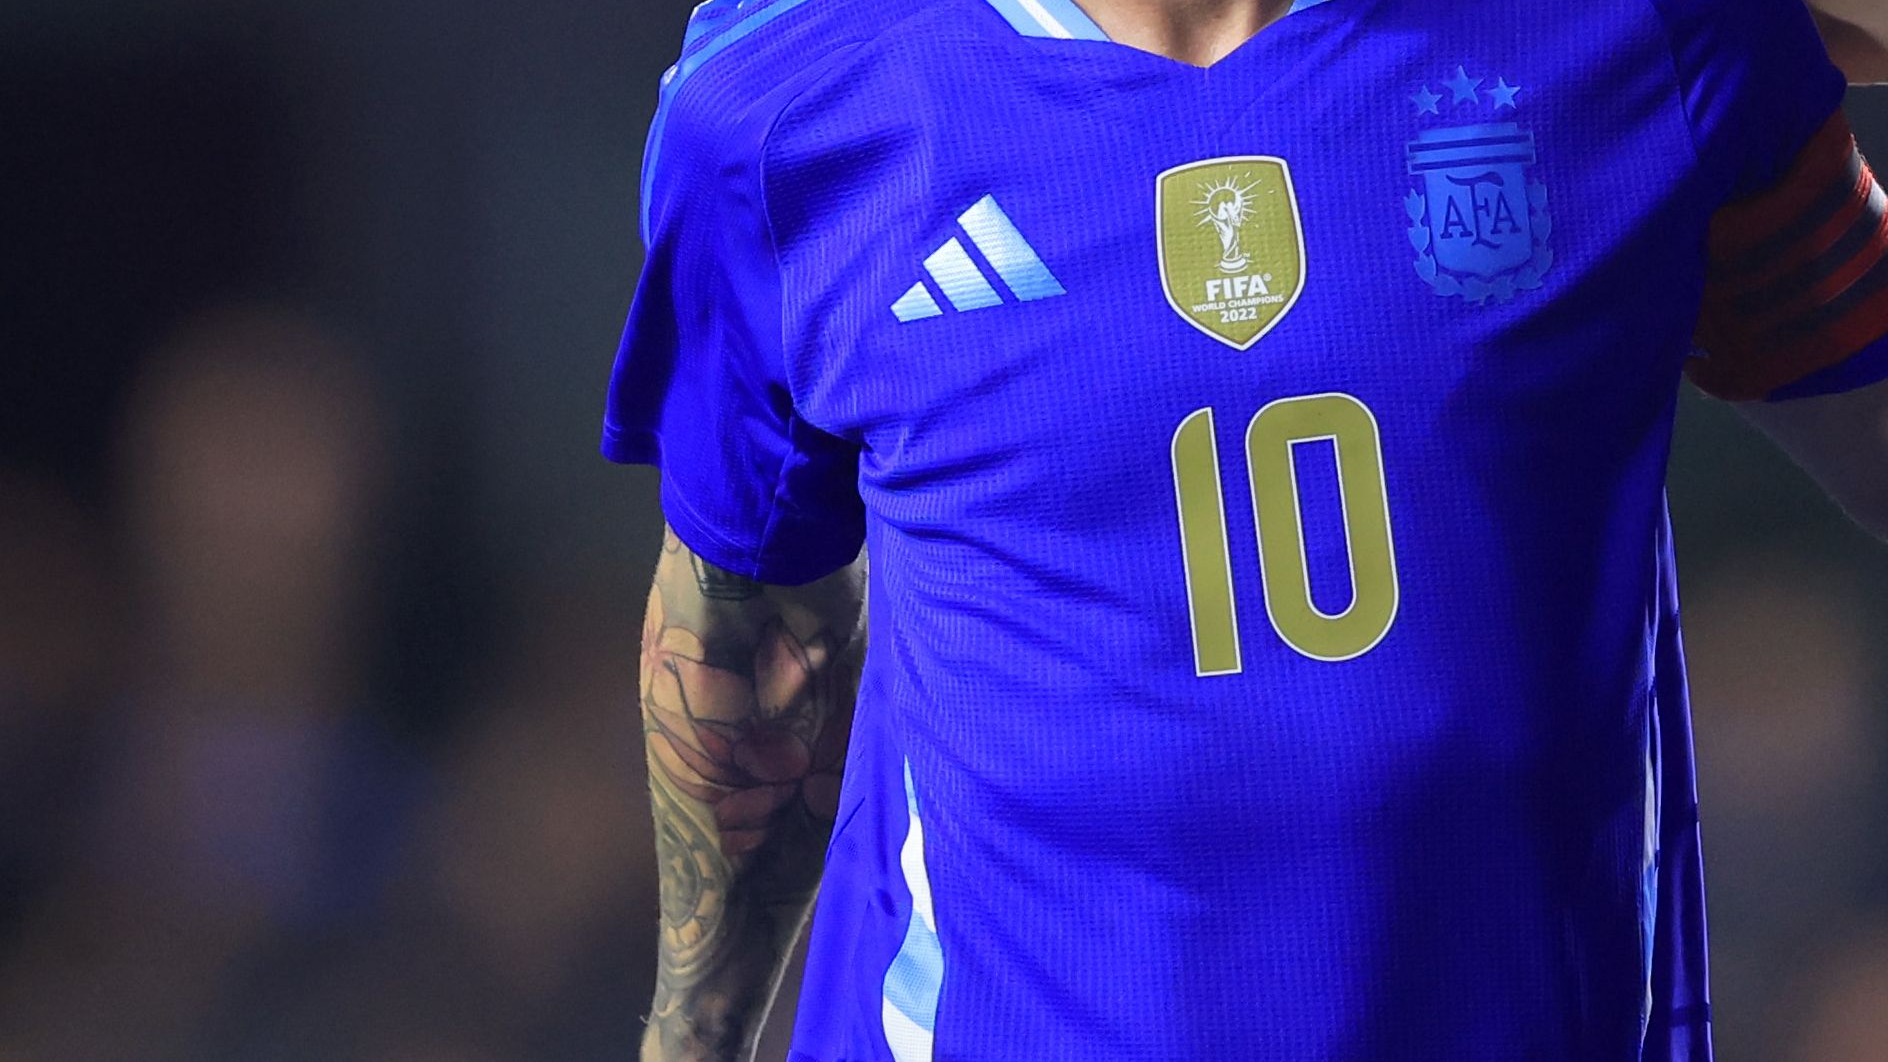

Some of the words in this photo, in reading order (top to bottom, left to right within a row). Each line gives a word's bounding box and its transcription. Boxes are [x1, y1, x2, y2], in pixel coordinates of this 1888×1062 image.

[1440, 171, 1521, 249] AFA
[1205, 274, 1269, 302] FIFA
[1192, 301, 1226, 313] WORLD
[1227, 294, 1284, 308] CHAMPIONS
[1220, 307, 1258, 323] 2022
[1171, 392, 1399, 677] 10
